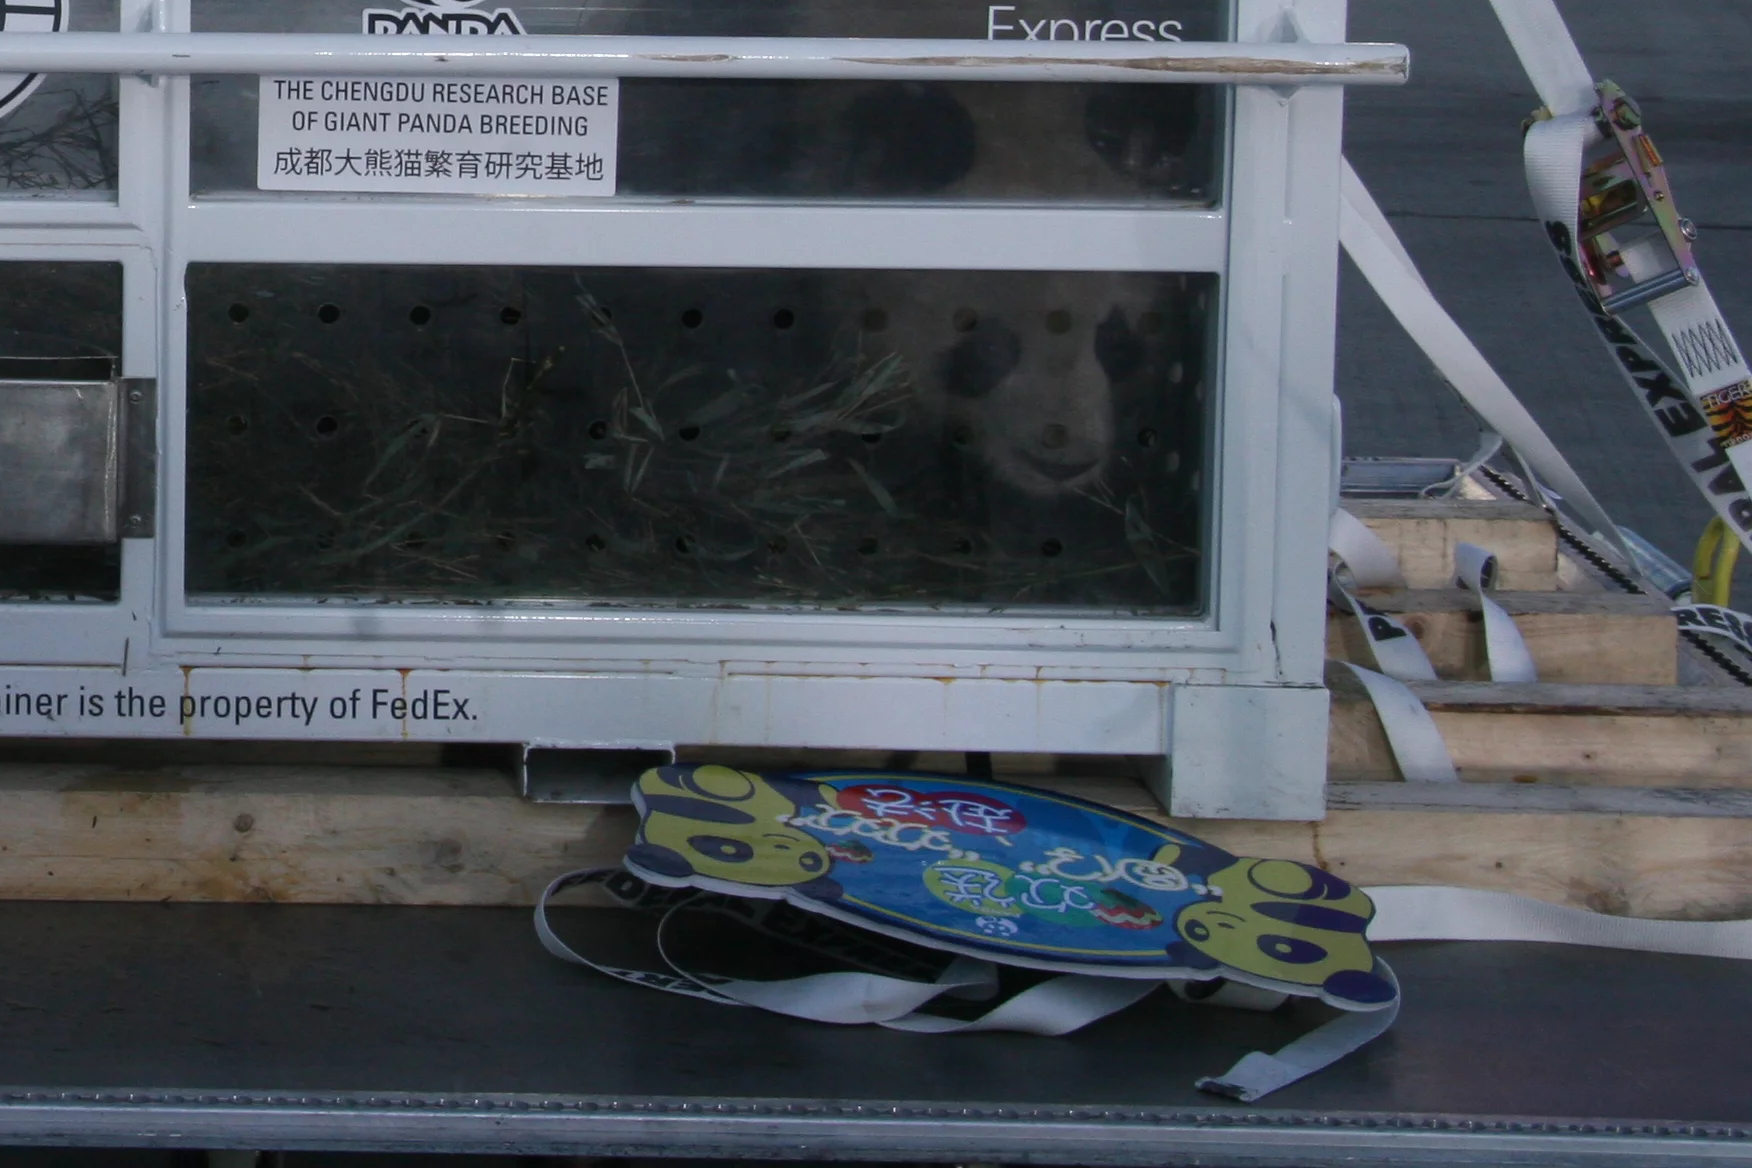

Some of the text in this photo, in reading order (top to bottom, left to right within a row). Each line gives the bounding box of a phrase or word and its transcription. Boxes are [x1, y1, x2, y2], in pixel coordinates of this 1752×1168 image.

[274, 80, 608, 106] THE CHENGDU RESEARCH BASE
[292, 111, 588, 136] OF GIANT PANDA BREEDING
[273, 147, 605, 181] 成都大熊猫繁育研究基地
[79, 685, 105, 718] is
[114, 685, 167, 719] the
[179, 687, 317, 727] property
[329, 688, 361, 720] of
[371, 689, 479, 722] FedEx.
